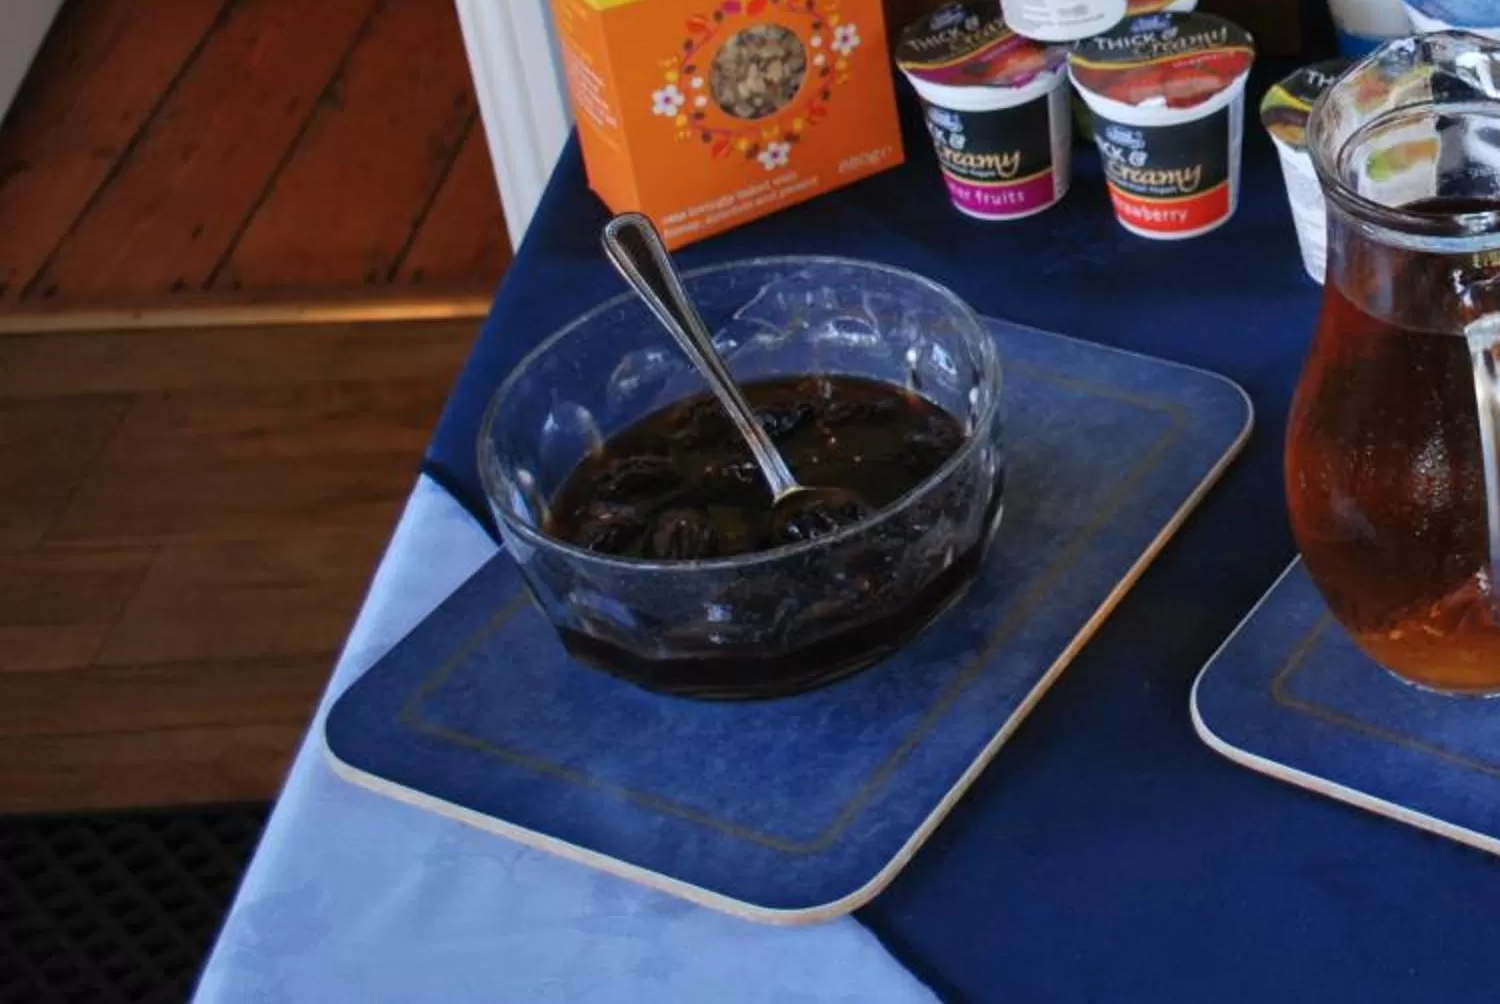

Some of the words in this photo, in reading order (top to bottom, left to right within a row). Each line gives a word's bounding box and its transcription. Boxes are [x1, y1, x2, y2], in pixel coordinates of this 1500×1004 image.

[1092, 31, 1155, 52] THICK
[1106, 158, 1203, 193] Creamy
[975, 188, 1026, 206] fruits
